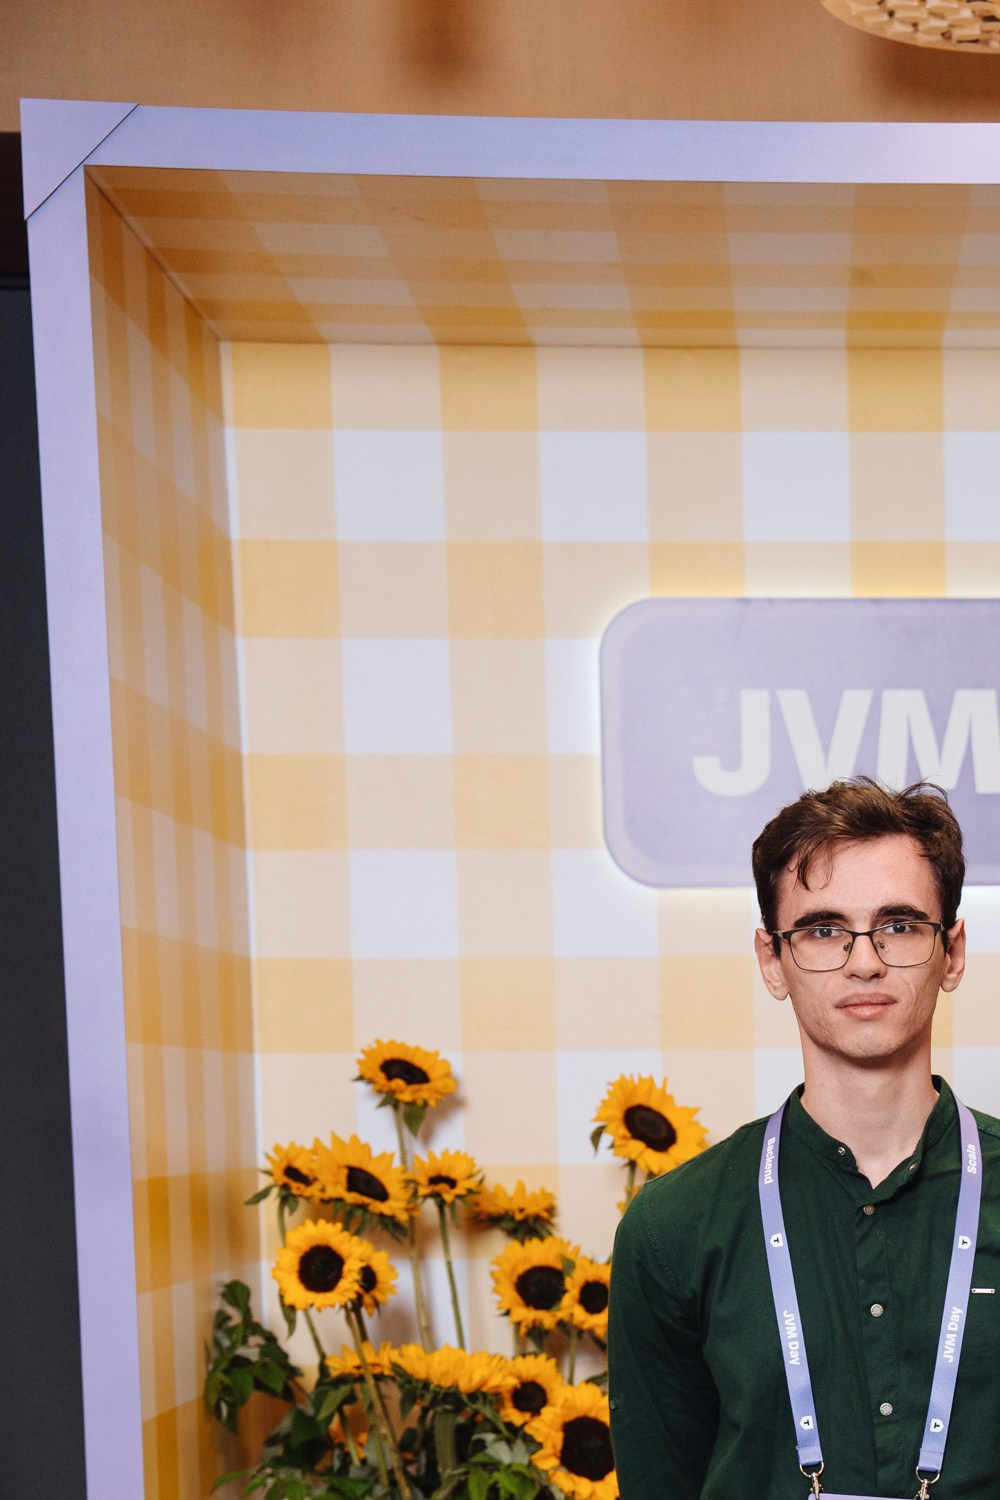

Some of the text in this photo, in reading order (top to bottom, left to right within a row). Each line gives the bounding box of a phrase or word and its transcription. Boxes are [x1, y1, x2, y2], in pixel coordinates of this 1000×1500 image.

[764, 1137, 776, 1185] Backend
[967, 1144, 976, 1174] Scala
[783, 1310, 800, 1366] JVM Day
[943, 1307, 963, 1363] JVM Day
